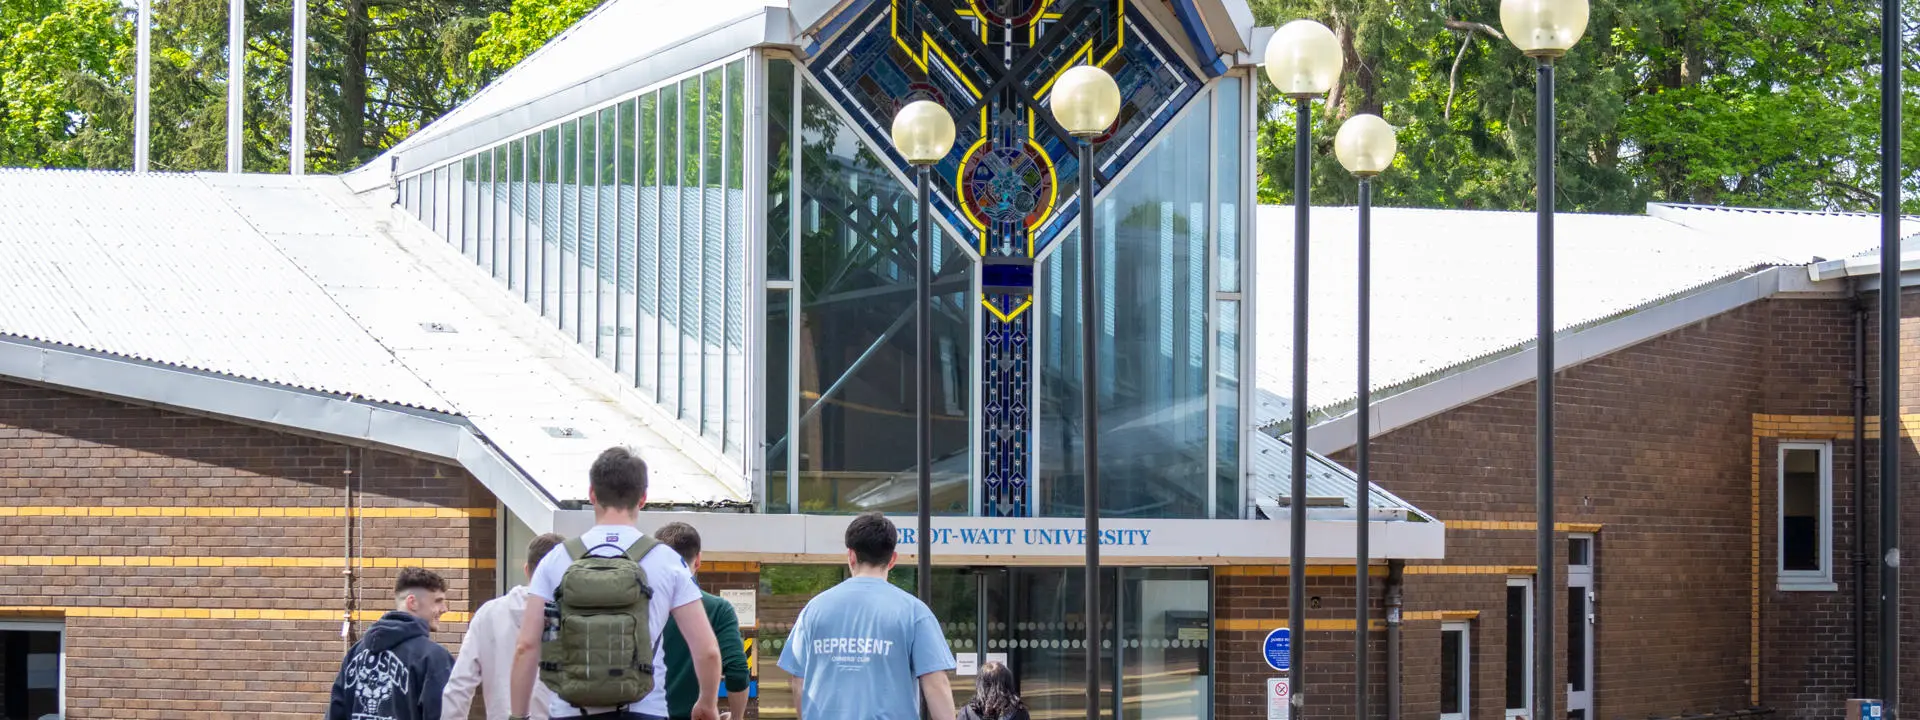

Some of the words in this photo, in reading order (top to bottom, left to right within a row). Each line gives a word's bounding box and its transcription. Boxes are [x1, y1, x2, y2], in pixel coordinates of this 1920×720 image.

[896, 527, 1016, 545] ROT-WATT
[813, 637, 894, 656] REPRESENT
[344, 648, 410, 695] CHOSEN
